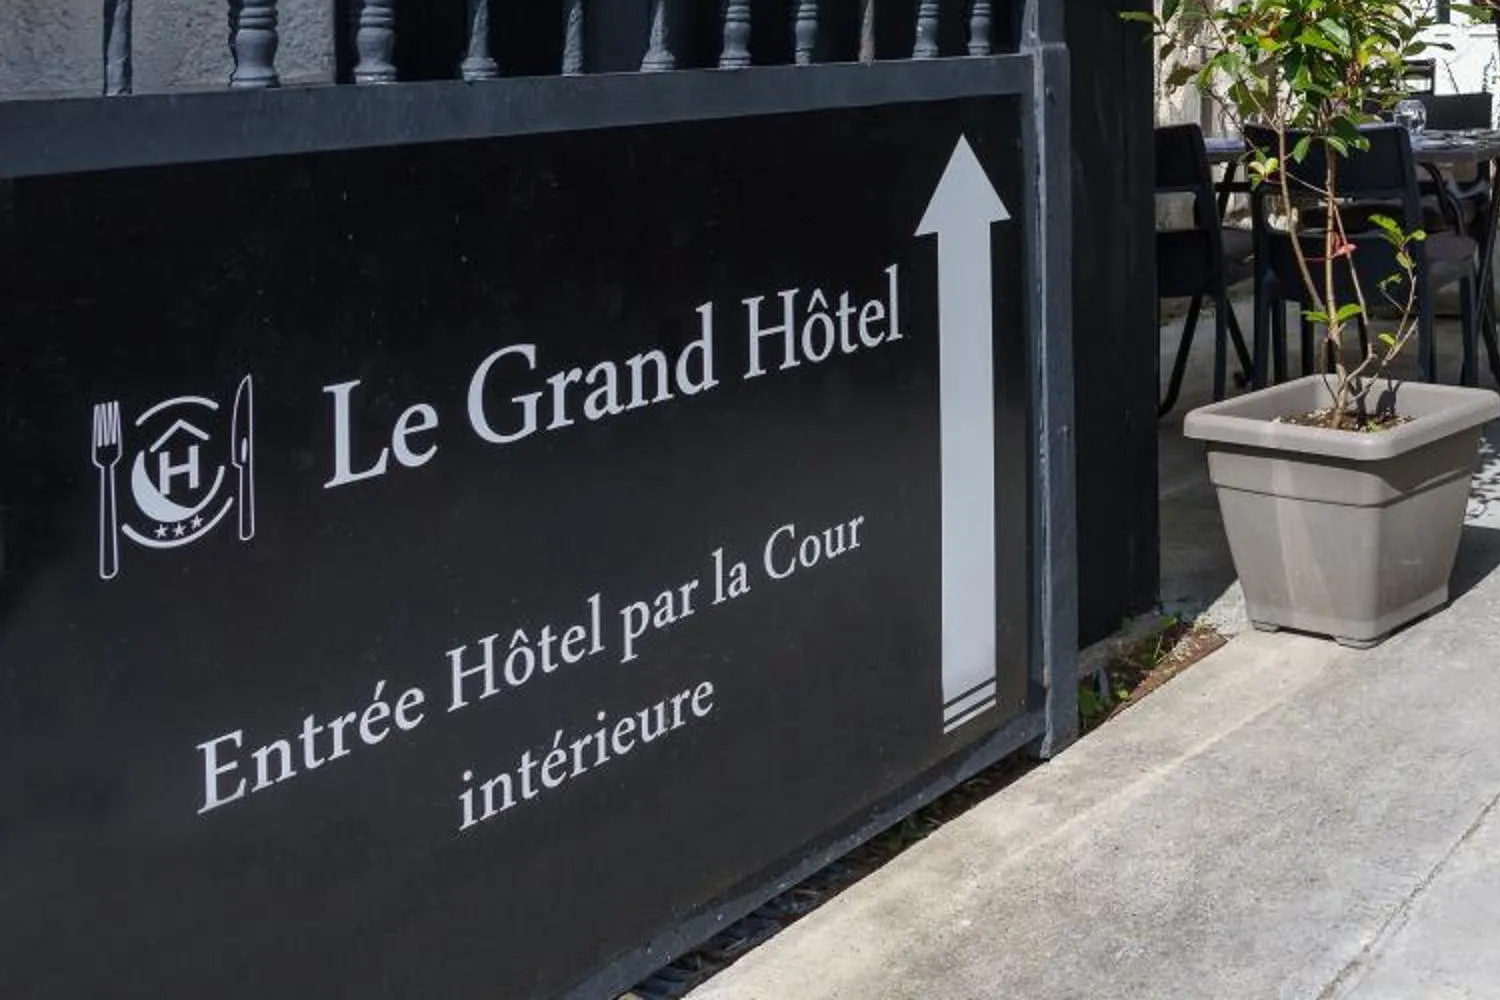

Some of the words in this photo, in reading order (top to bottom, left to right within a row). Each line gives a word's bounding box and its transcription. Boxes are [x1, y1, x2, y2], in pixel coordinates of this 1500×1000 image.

[322, 378, 439, 490] Le
[465, 303, 720, 445] Grand
[741, 265, 905, 380] Hôtel
[195, 679, 425, 815] Entrée
[444, 595, 605, 714] Hôtel
[619, 578, 699, 661] par
[711, 549, 750, 605] la
[762, 511, 865, 580] Cour
[457, 678, 715, 830] intérieure
